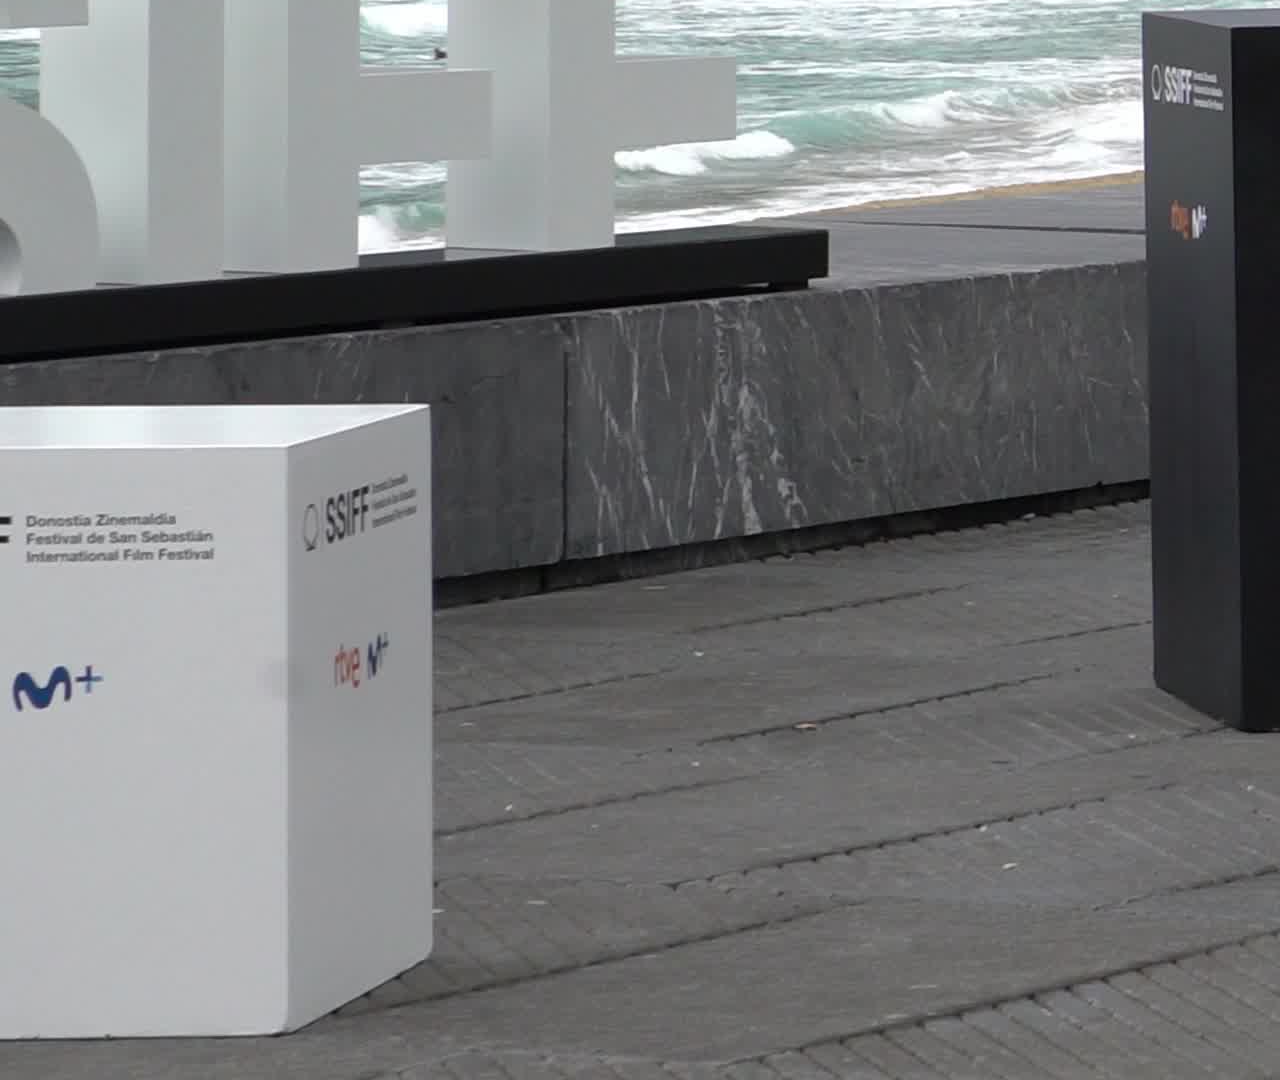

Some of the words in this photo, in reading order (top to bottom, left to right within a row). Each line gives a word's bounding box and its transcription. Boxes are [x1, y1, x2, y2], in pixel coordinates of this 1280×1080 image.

[1164, 65, 1192, 105] SSIFF
[26, 515, 91, 527] Donostia
[96, 513, 176, 526] Zinemaldia
[326, 485, 369, 543] SSIFF
[26, 533, 82, 545] Festival
[87, 532, 105, 544] de
[109, 531, 136, 544] San
[26, 550, 119, 563] International
[123, 549, 154, 561] Film
[158, 548, 214, 561] Festival
